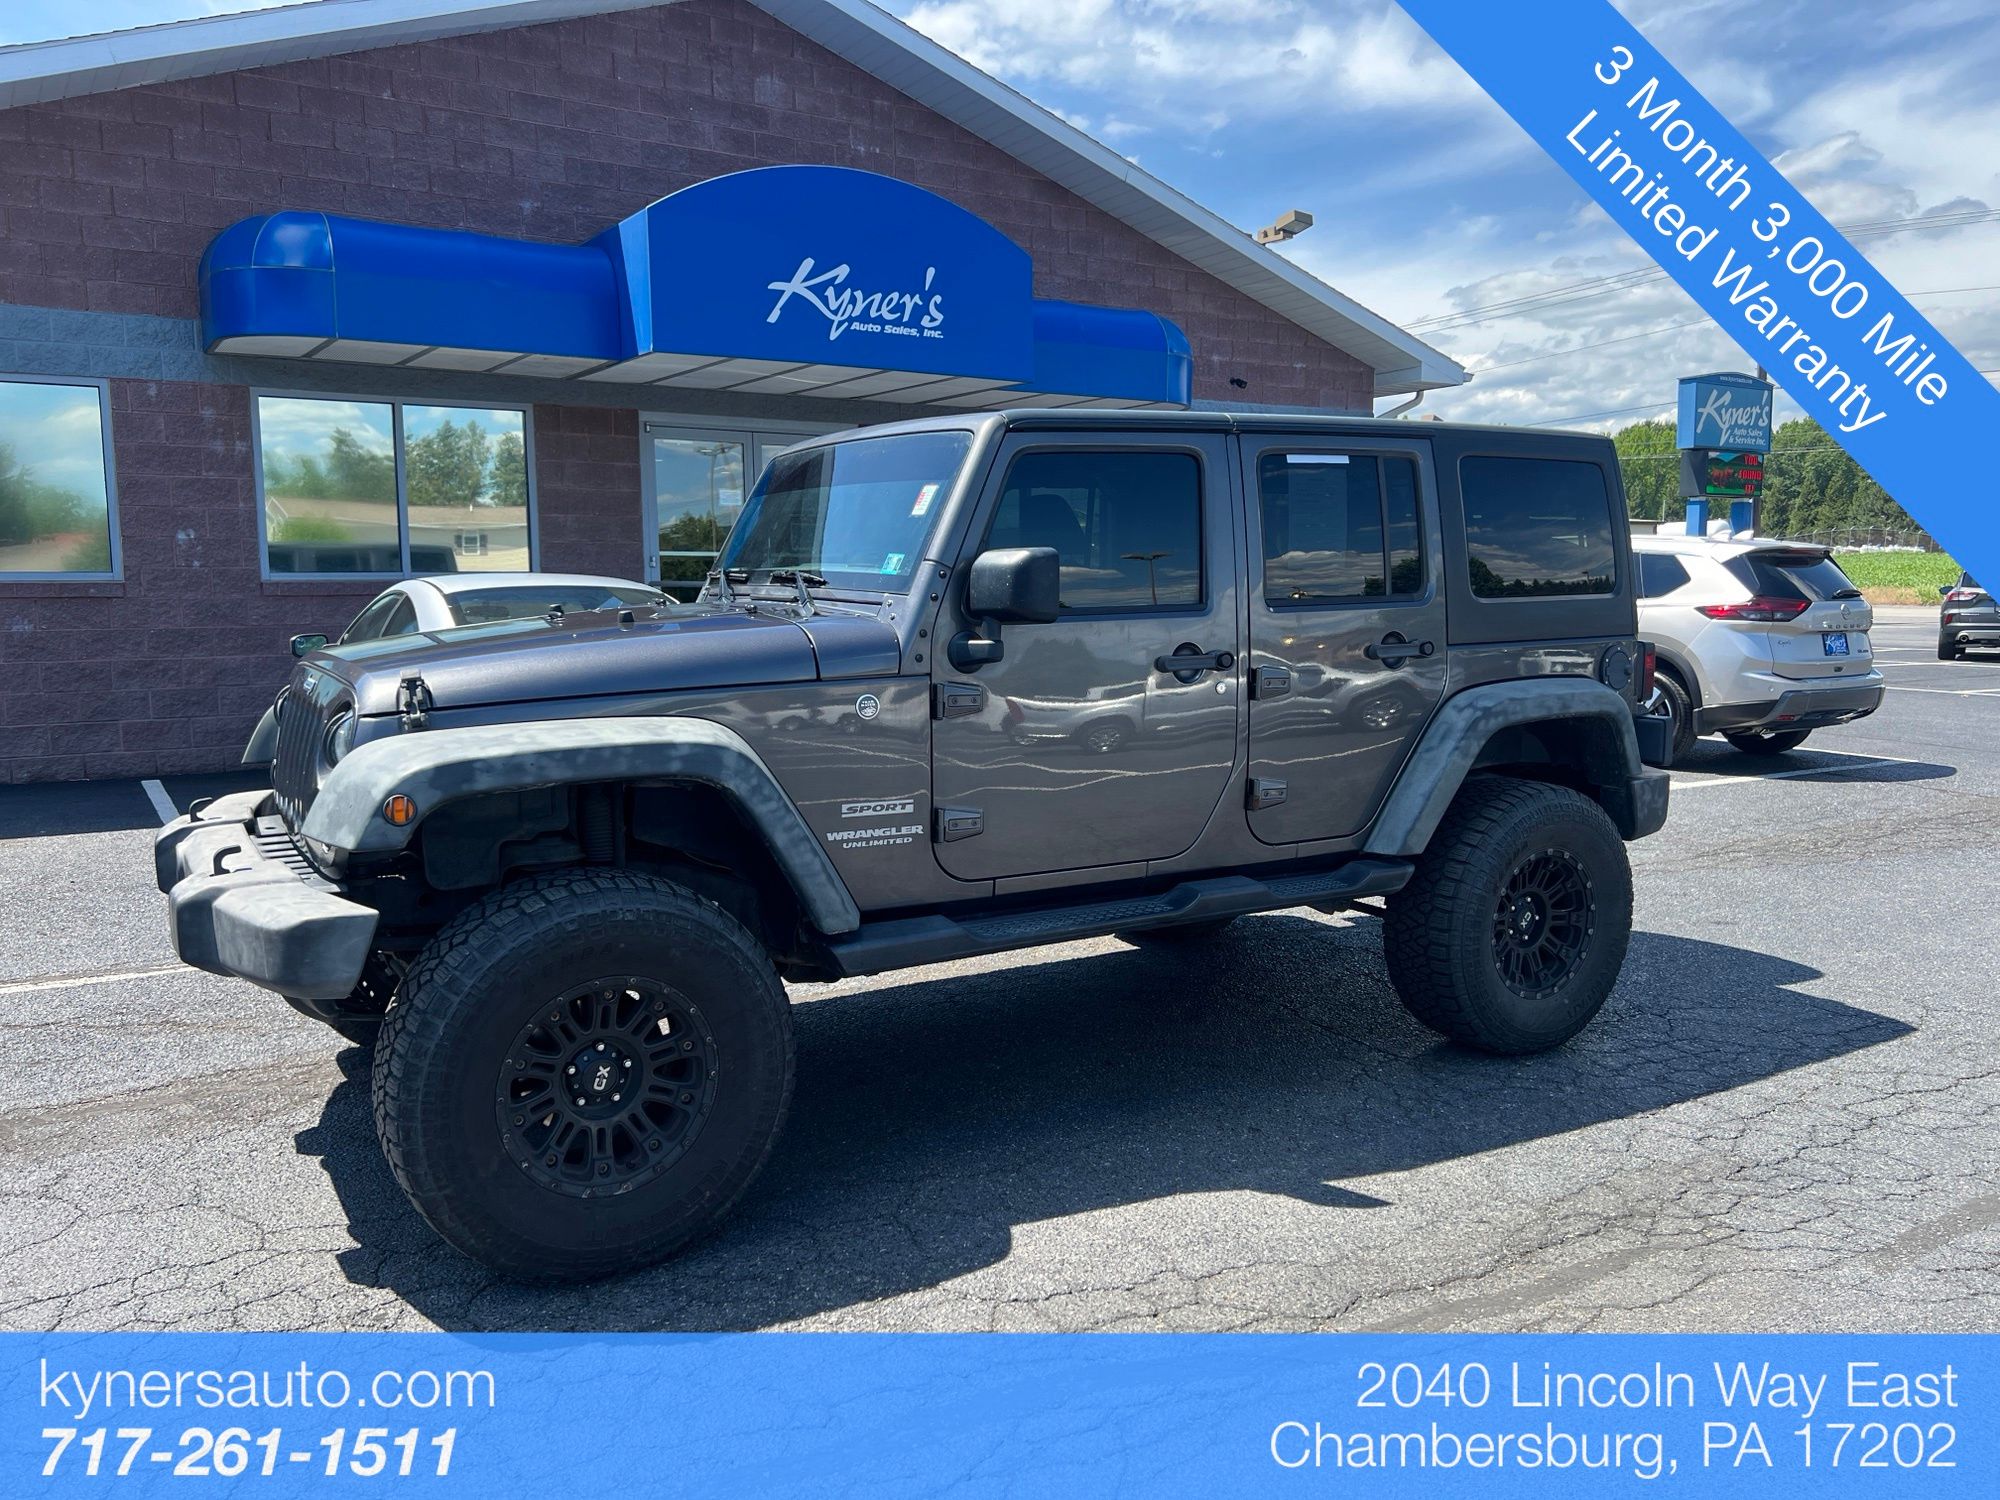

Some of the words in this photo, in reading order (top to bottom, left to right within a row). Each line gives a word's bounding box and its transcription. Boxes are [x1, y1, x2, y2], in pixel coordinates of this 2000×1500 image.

[766, 257, 945, 341] Kyner's
[850, 321, 881, 333] Auto
[884, 324, 920, 338] Sales,
[923, 328, 944, 339] Inc.
[1696, 389, 1769, 447] Kyner's
[1728, 435, 1734, 444] &
[1735, 435, 1756, 445] Service
[845, 801, 914, 815] SPORT
[826, 824, 924, 842] WRANGLER
[842, 836, 913, 849] UNLIMITED
